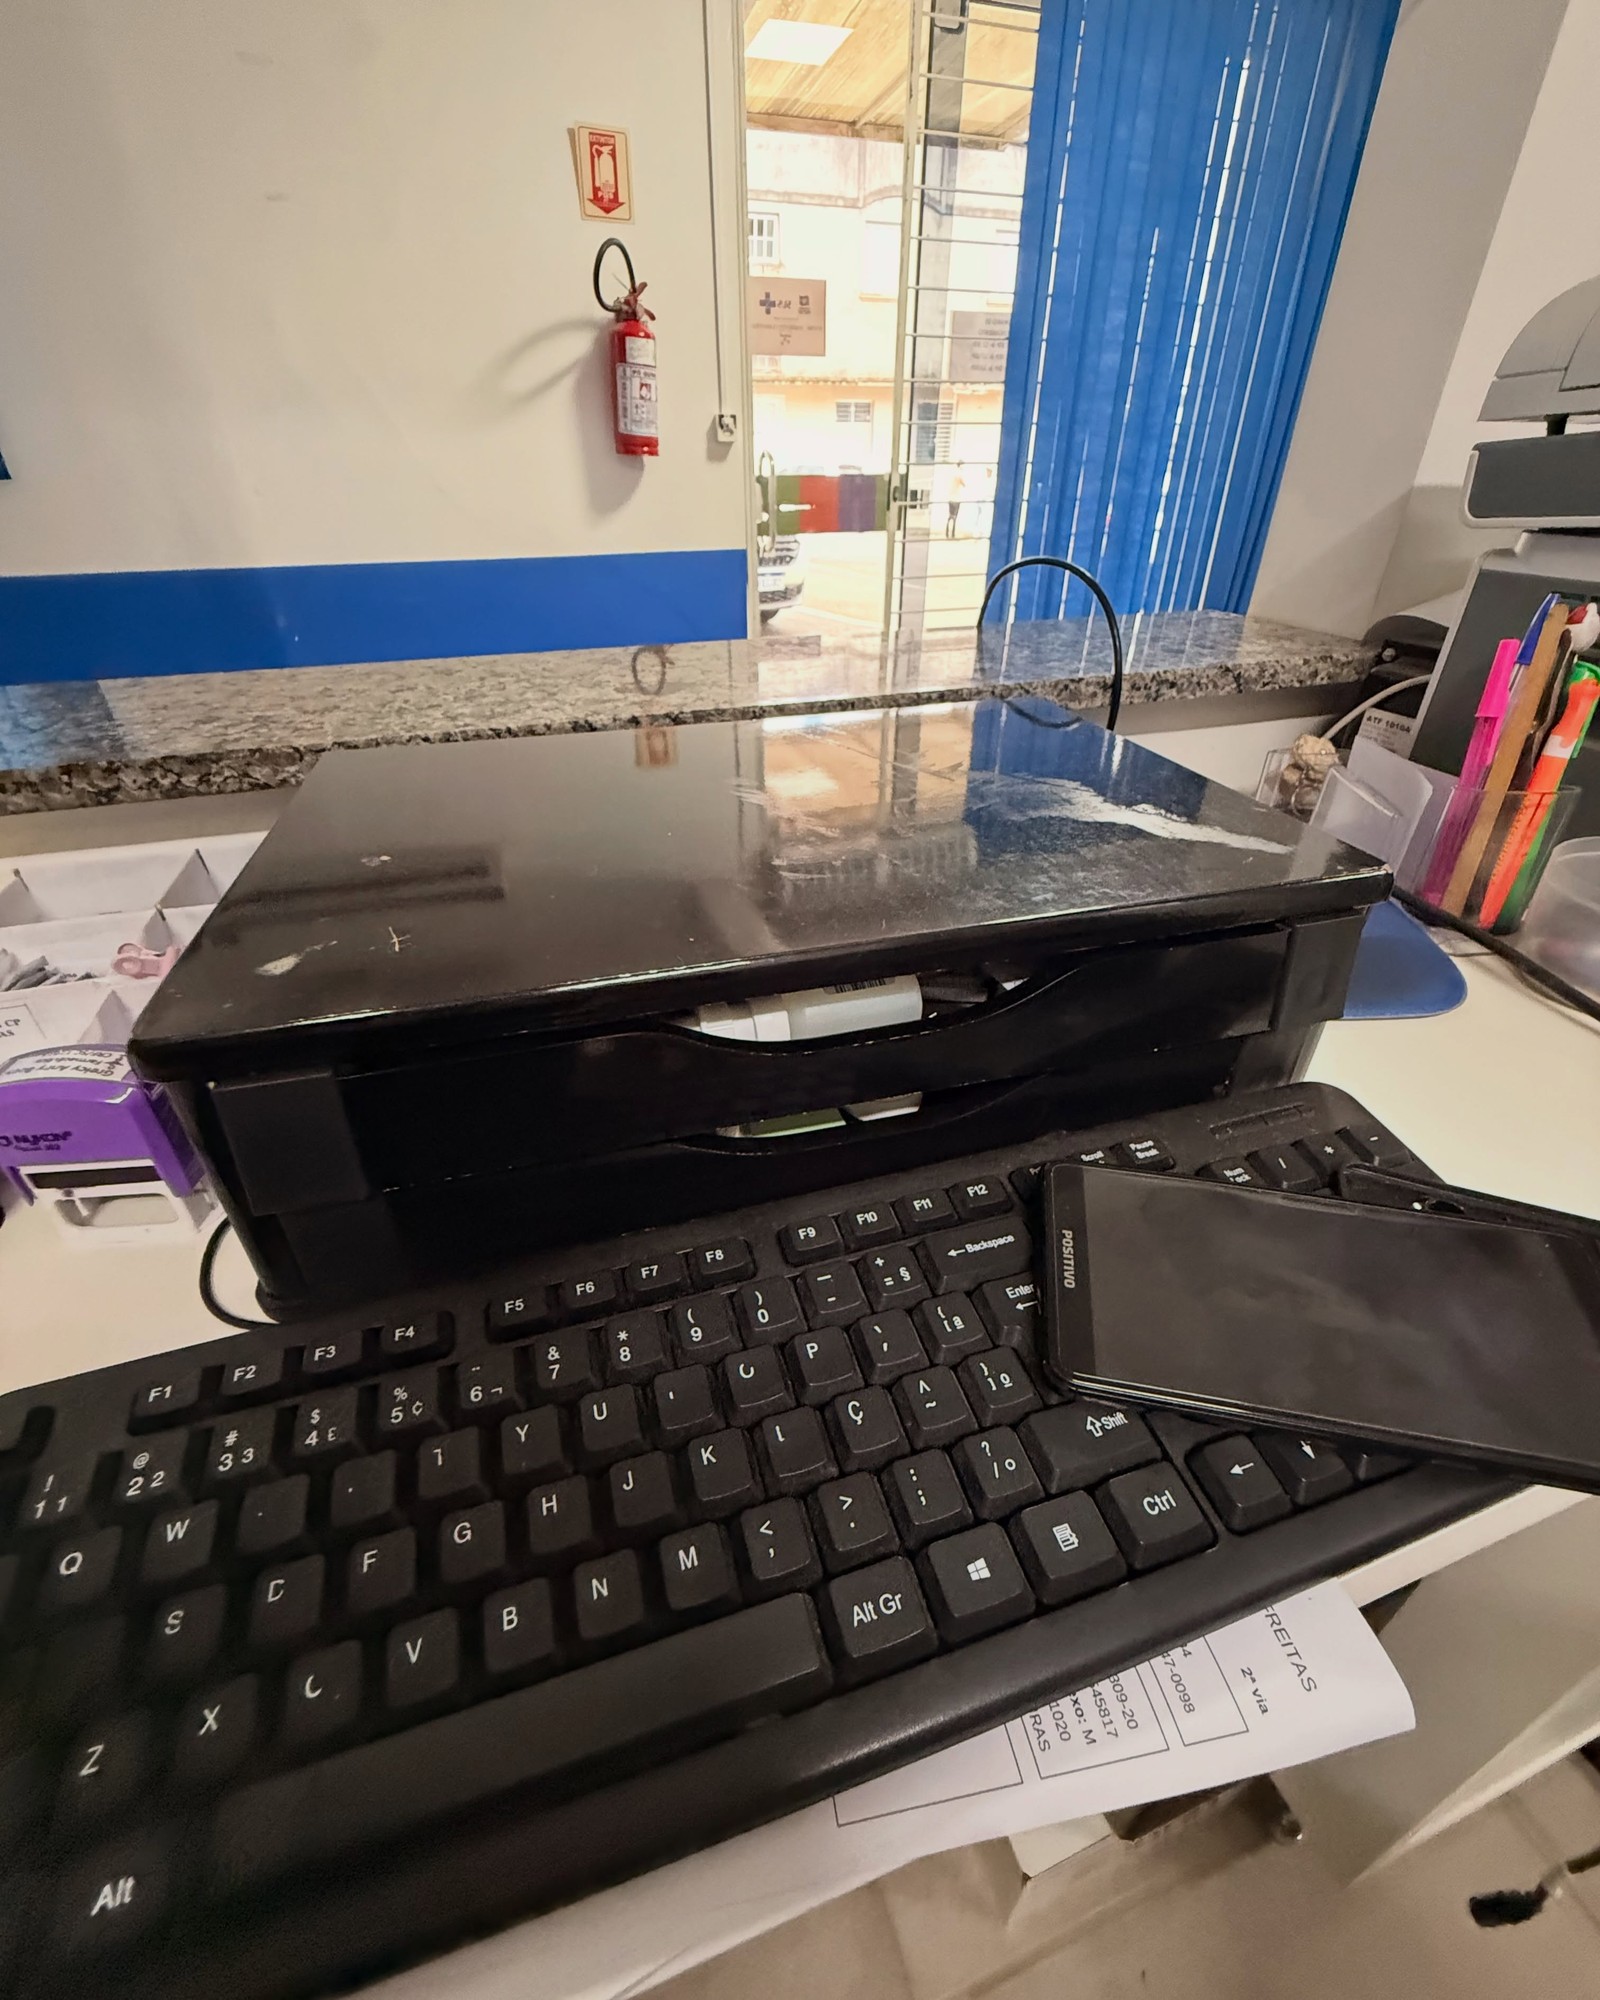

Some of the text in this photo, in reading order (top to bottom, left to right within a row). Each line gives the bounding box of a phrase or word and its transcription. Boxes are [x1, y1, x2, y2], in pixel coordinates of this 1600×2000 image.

[966, 1183, 989, 1197] F12
[912, 1197, 933, 1211] F11
[856, 1211, 878, 1225] F10
[798, 1226, 816, 1240] F9
[964, 1234, 1015, 1253] Backspace
[705, 1249, 724, 1263] F8
[1061, 1229, 1076, 1289] POSITIVO
[640, 1264, 659, 1279] F7
[575, 1281, 595, 1296] F6
[1005, 1284, 1034, 1299] Enter
[504, 1298, 525, 1314] F5
[757, 1308, 769, 1324] 0
[394, 1325, 415, 1342] F4
[690, 1326, 703, 1342] 9
[314, 1345, 336, 1361] F3
[619, 1346, 631, 1362] 8
[806, 1342, 819, 1359] P
[233, 1364, 257, 1382] F2
[548, 1363, 560, 1380] 7
[148, 1385, 172, 1403] F1
[470, 1385, 483, 1402] 6
[390, 1406, 404, 1424] 5
[592, 1402, 608, 1421] U
[847, 1400, 864, 1425] Ç
[1100, 1411, 1129, 1430] Shift
[304, 1430, 319, 1446] 4
[515, 1424, 529, 1443] Y
[217, 1447, 254, 1472] 3 3
[700, 1445, 717, 1466] K
[126, 1470, 165, 1497] 2 2
[622, 1470, 634, 1491] J
[35, 1496, 67, 1519] 1 1
[541, 1494, 558, 1516] H
[1142, 1489, 1177, 1515] Ctrl
[166, 1518, 190, 1543] W
[453, 1521, 472, 1544] G
[59, 1551, 83, 1575] Q
[362, 1549, 378, 1573] F
[678, 1545, 699, 1571] M
[591, 1577, 609, 1601] N
[502, 1606, 518, 1631] B
[853, 1593, 902, 1628] Alt Gr
[164, 1610, 184, 1635] S
[405, 1637, 423, 1664] V
[1252, 1687, 1269, 1715] via
[199, 1705, 221, 1736] X
[1029, 1714, 1051, 1752] RAS
[1082, 1729, 1097, 1745] M
[79, 1743, 104, 1777] Z
